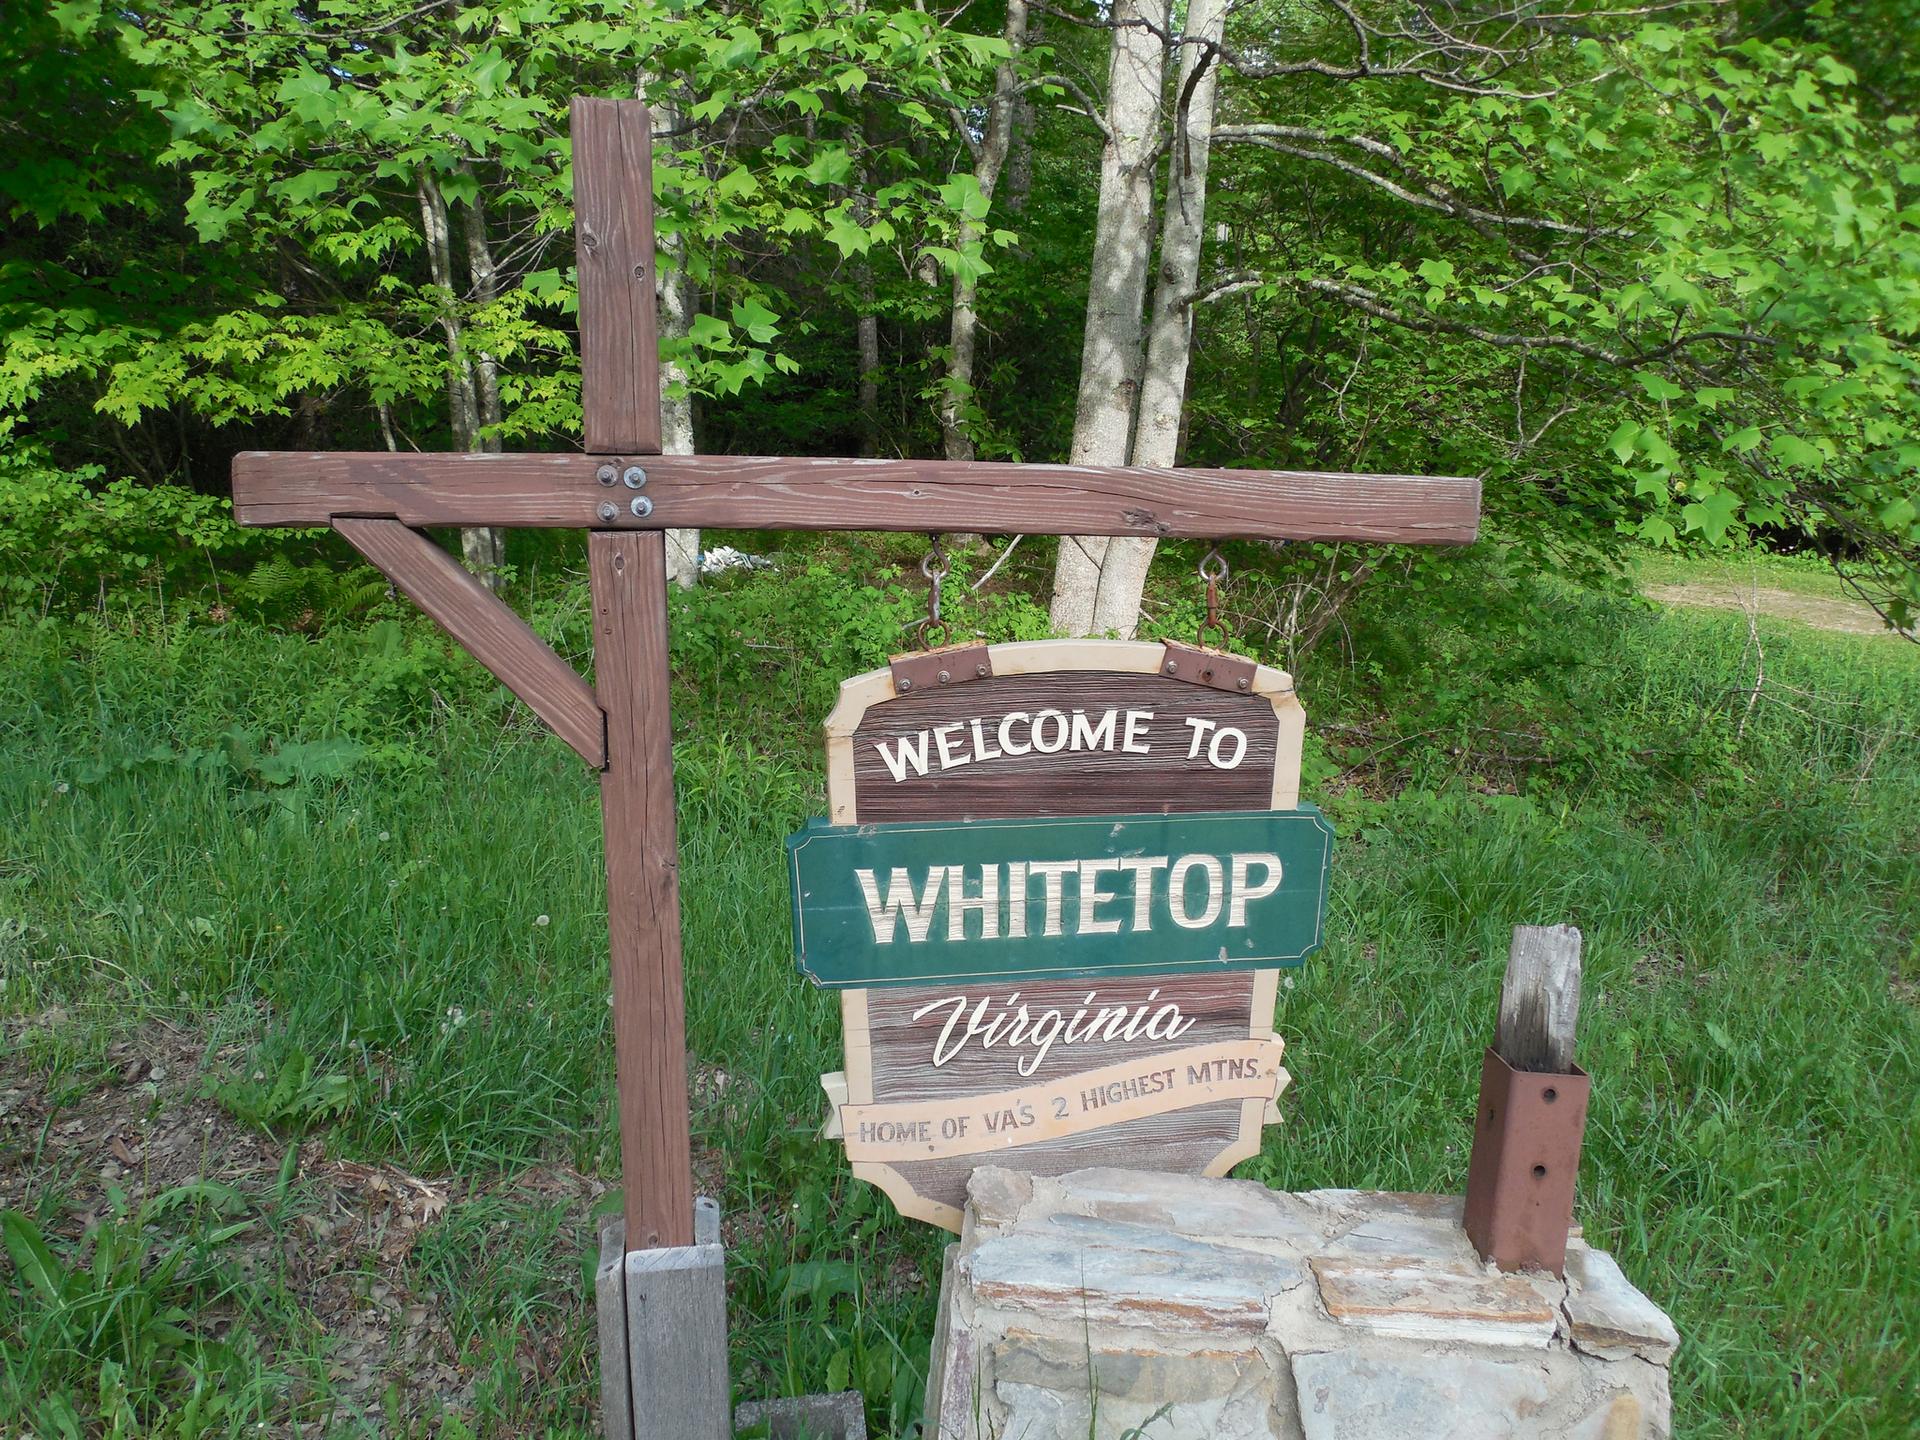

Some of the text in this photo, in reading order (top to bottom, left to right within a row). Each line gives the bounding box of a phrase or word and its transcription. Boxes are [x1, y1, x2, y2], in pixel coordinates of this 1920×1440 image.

[873, 708, 1248, 783] WELCOME TO
[855, 852, 1283, 944] WHITETOP
[913, 989, 1196, 1077] Virginia
[859, 1120, 931, 1144] HOME
[942, 1116, 968, 1138] OF
[1050, 1097, 1070, 1119] 2
[1080, 1068, 1176, 1112] HIGHEST
[1186, 1056, 1262, 1085] MTNS.
